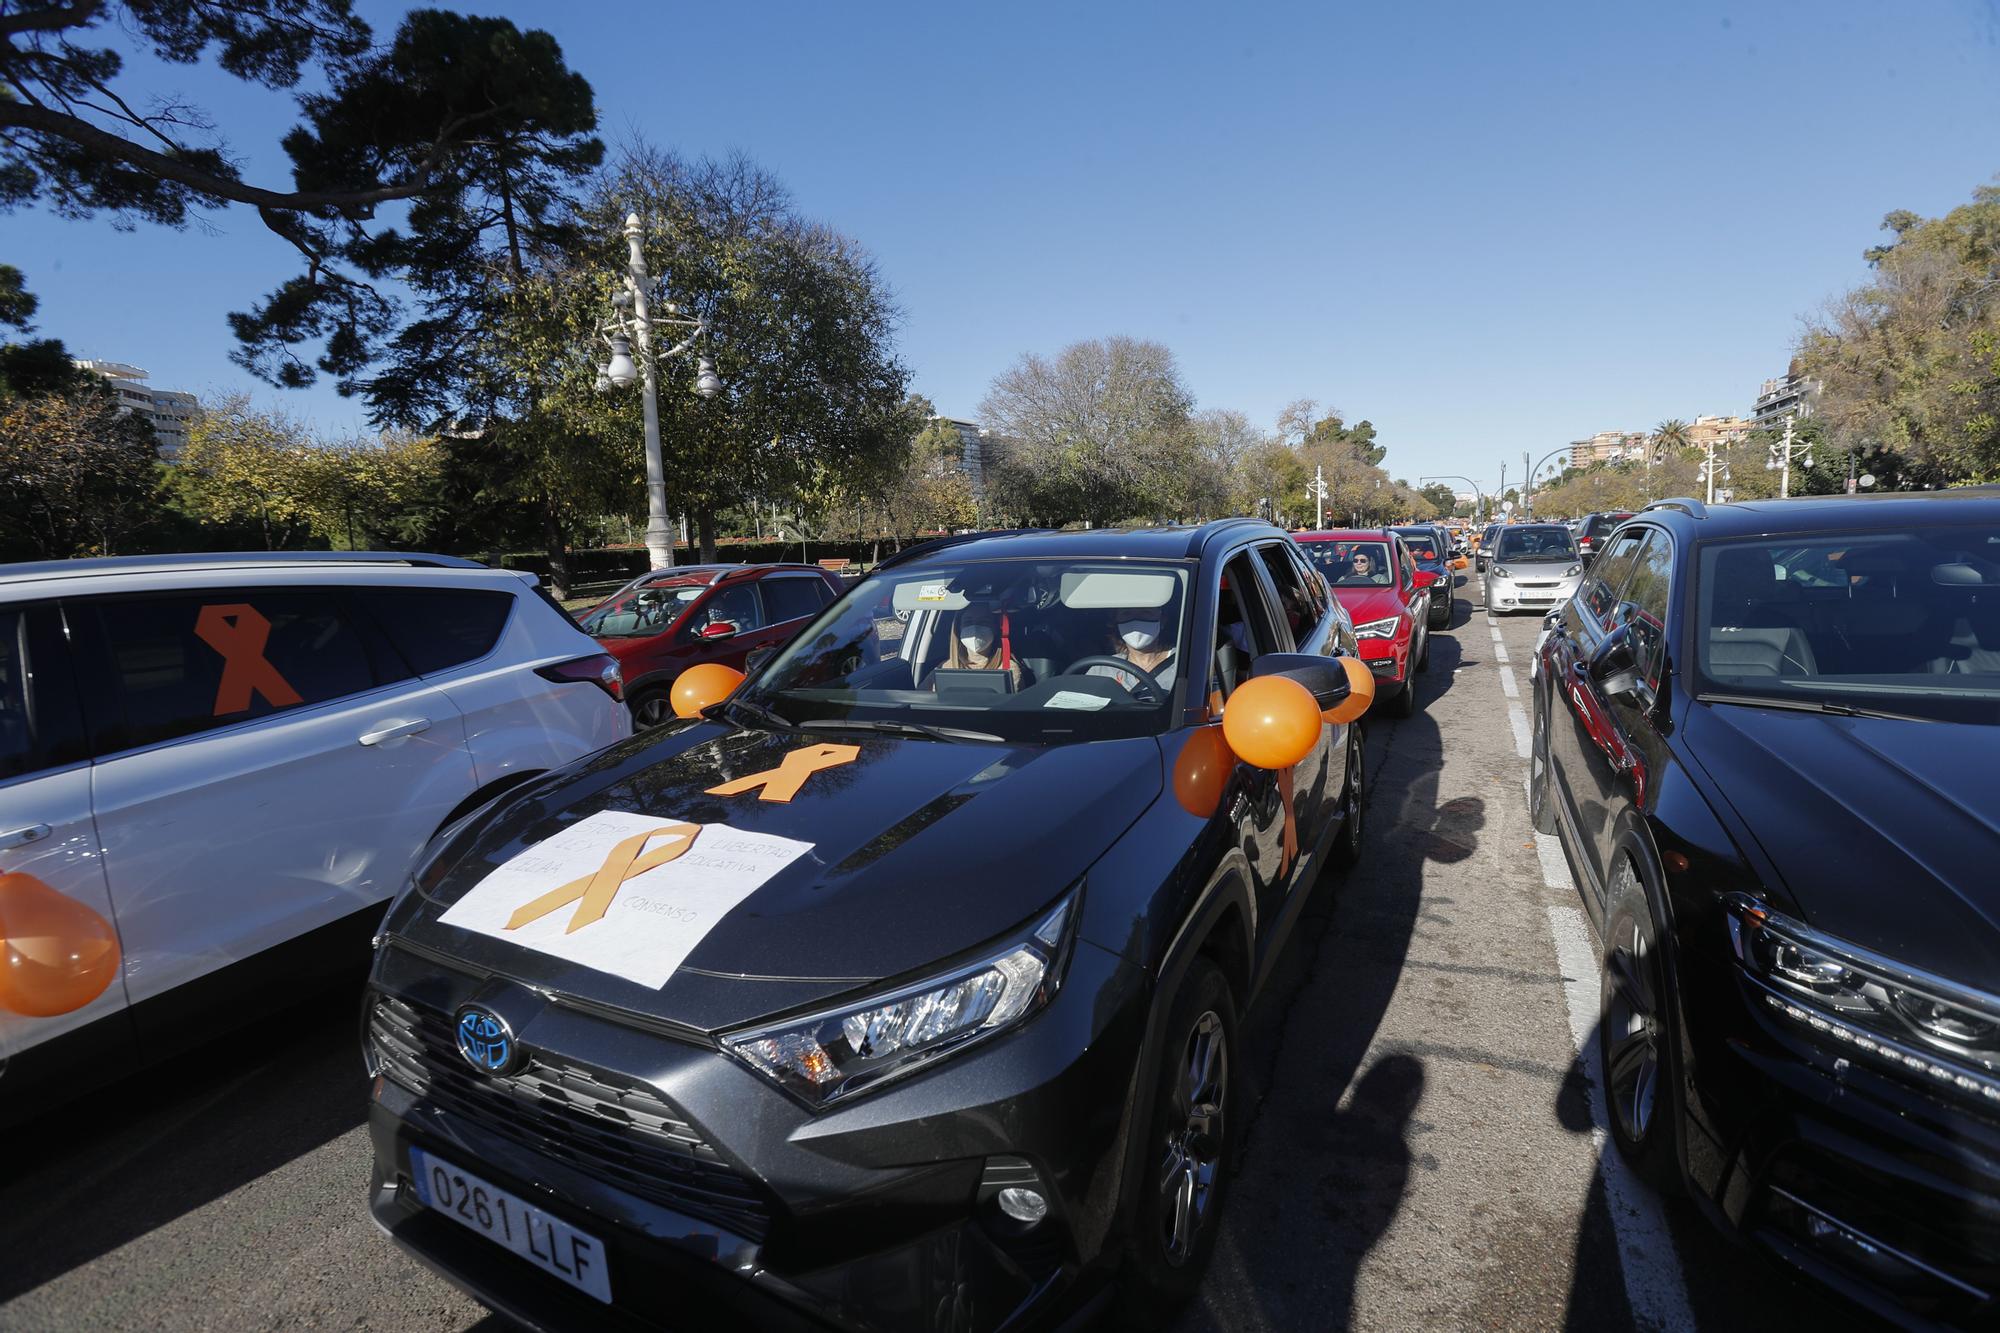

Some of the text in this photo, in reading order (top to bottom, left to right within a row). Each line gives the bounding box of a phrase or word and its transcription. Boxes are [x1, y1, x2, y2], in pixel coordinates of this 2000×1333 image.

[577, 821, 631, 835] STOP
[554, 838, 600, 853] LEY
[710, 839, 794, 859] LIBERTAD
[680, 854, 757, 872] EDUCATIVA
[623, 895, 698, 922] CONSENSO
[433, 1166, 591, 1281] 0261 LLF
